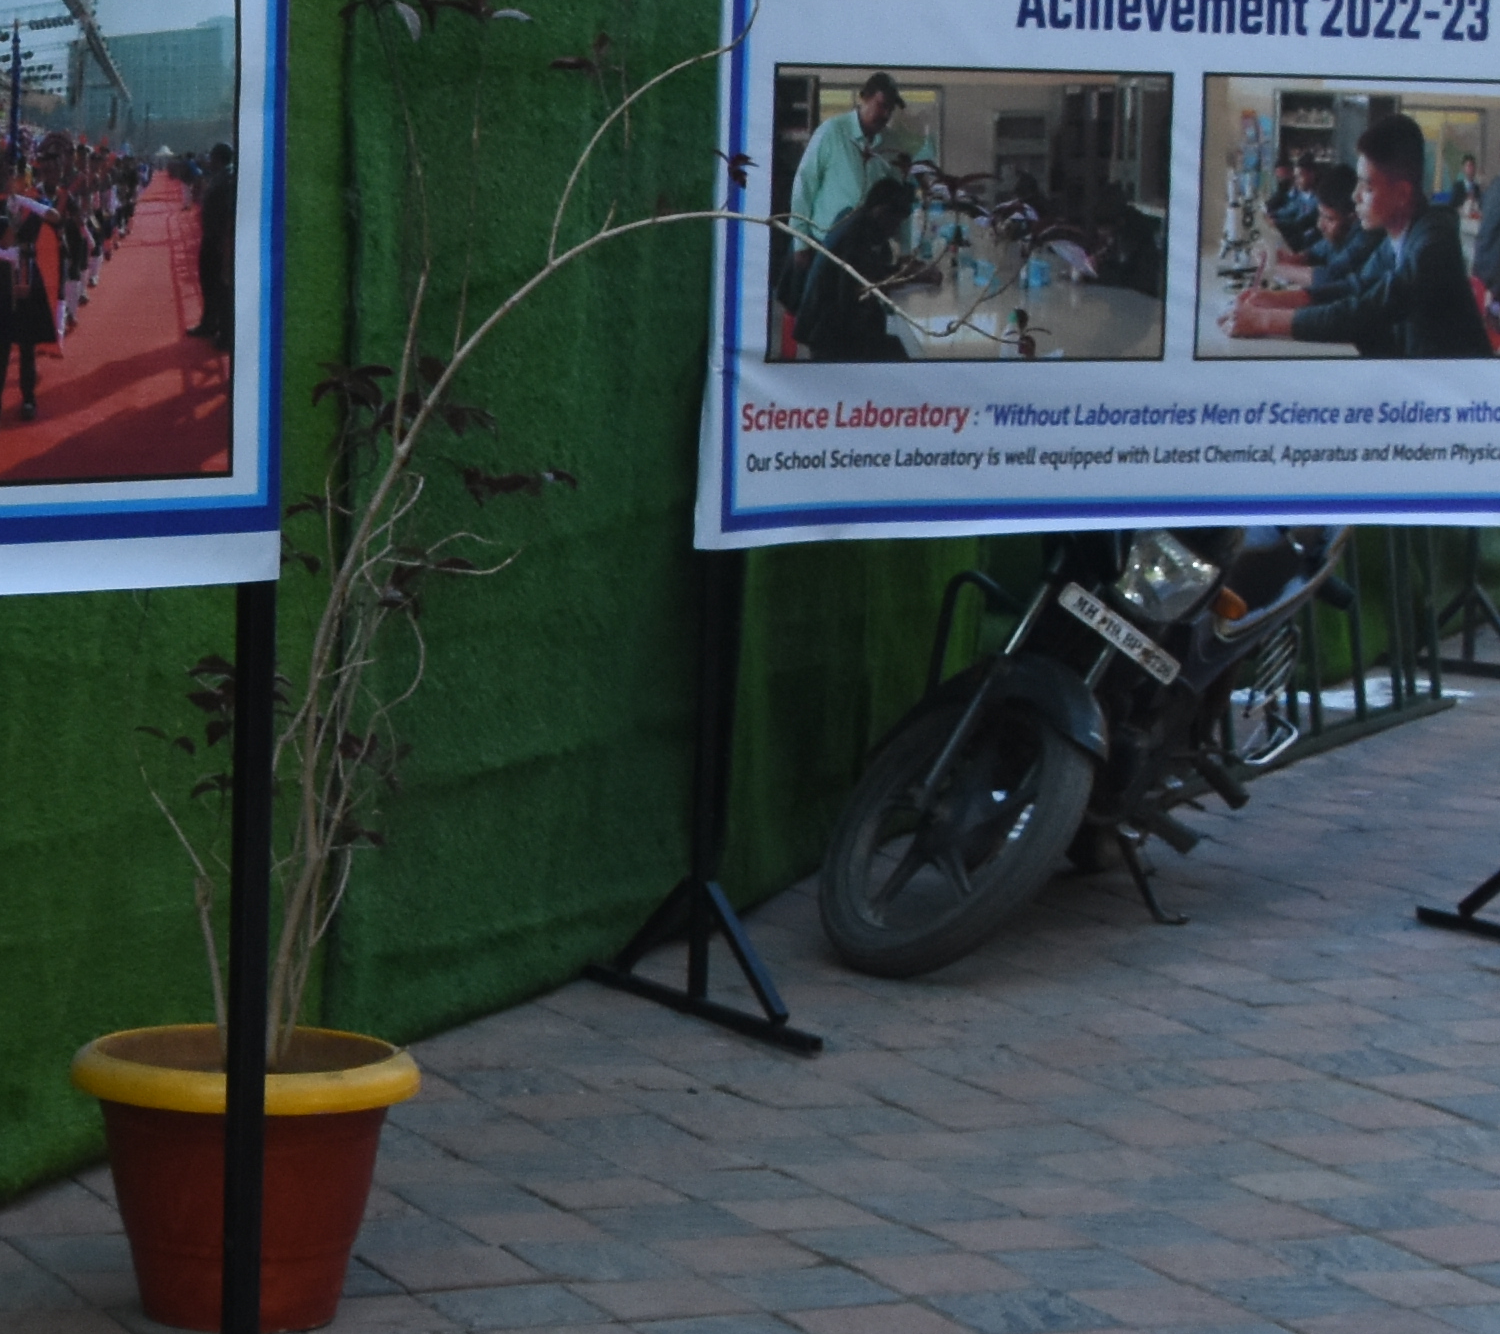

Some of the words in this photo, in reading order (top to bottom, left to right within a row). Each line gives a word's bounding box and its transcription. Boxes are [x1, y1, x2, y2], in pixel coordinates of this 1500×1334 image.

[742, 402, 828, 432] Science
[836, 401, 970, 434] Laboratory
[1074, 404, 1197, 427] Laboratories
[1201, 404, 1239, 425] Men
[1244, 402, 1267, 425] of
[1268, 402, 1340, 425] Science
[1344, 407, 1373, 424] are
[1378, 401, 1451, 424] Soldiers
[746, 453, 771, 473] Our
[774, 450, 827, 471] School
[830, 448, 892, 469] Science
[894, 447, 983, 470] Laboratory
[987, 447, 1000, 467] is
[1004, 446, 1036, 466] well
[1039, 445, 1113, 470] equipped
[1117, 444, 1150, 465] with
[1153, 445, 1200, 464] Latest
[1282, 444, 1358, 467] Apparatus
[1361, 444, 1389, 462] and
[1393, 444, 1447, 462] Modern
